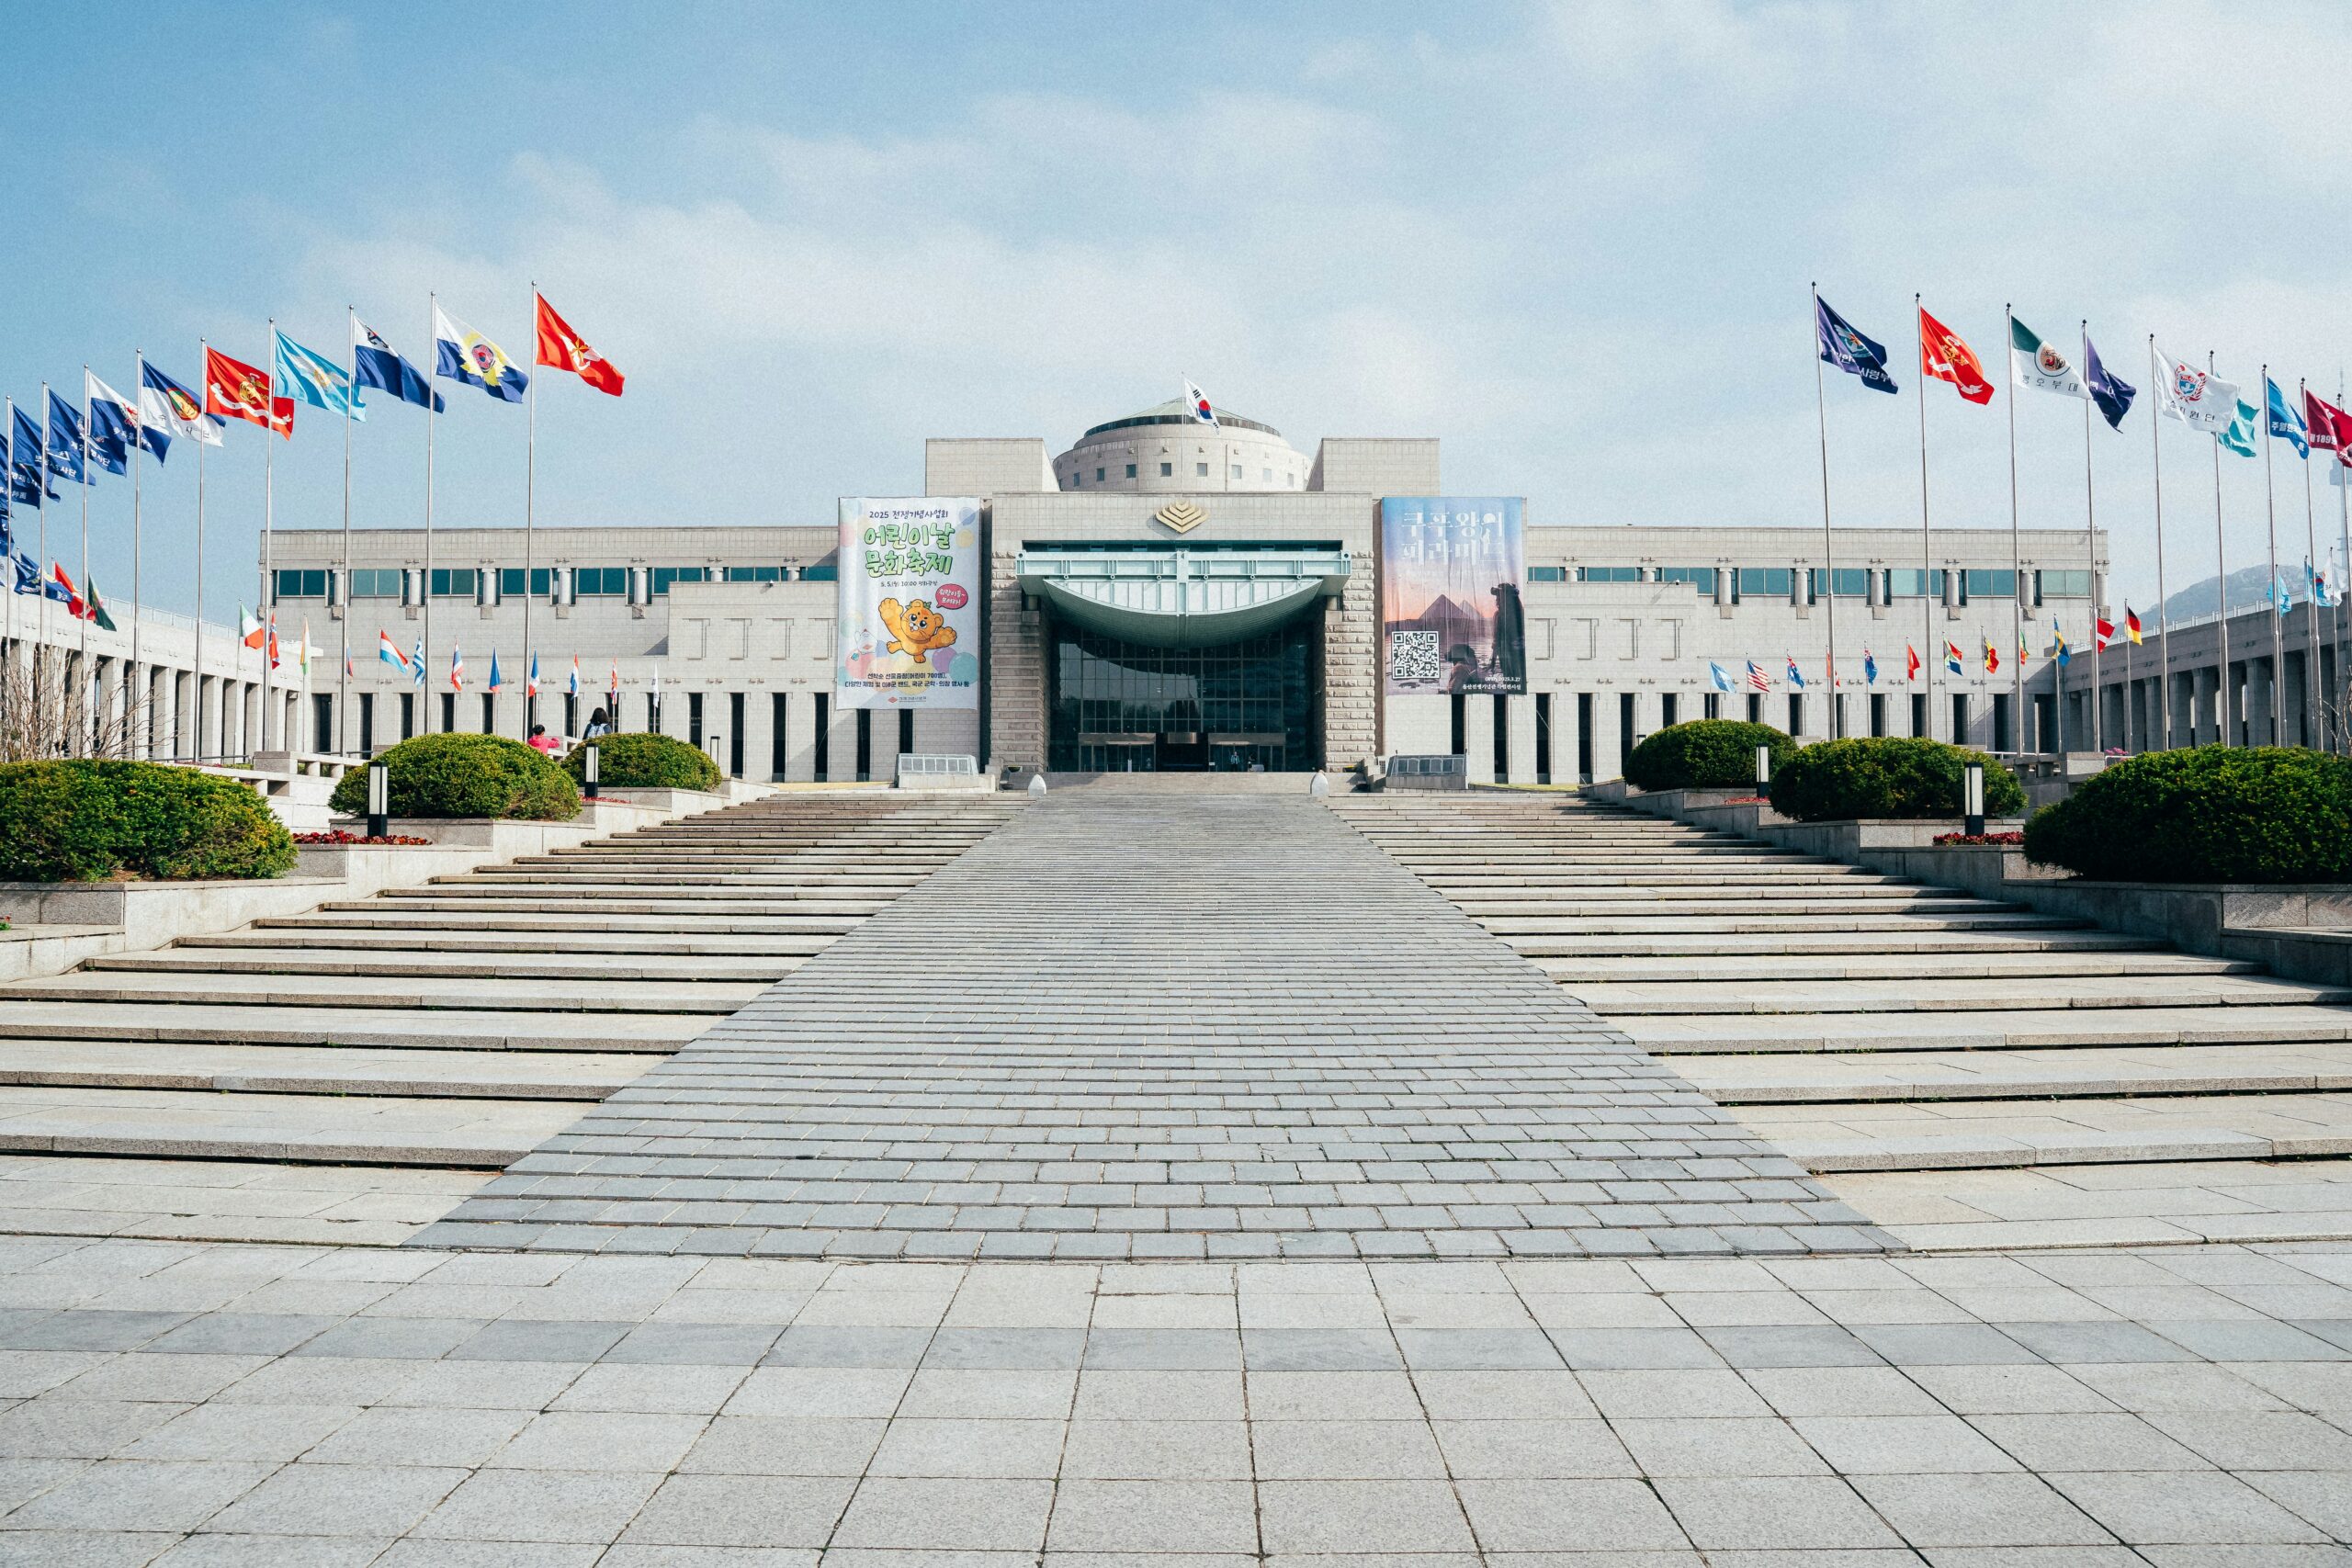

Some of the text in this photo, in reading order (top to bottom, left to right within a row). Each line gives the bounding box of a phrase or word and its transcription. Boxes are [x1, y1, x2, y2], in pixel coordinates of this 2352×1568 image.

[869, 509, 949, 520] 2025 전쟁기념사업회
[864, 522, 956, 549] 어린이날
[865, 547, 954, 578] 문화축제
